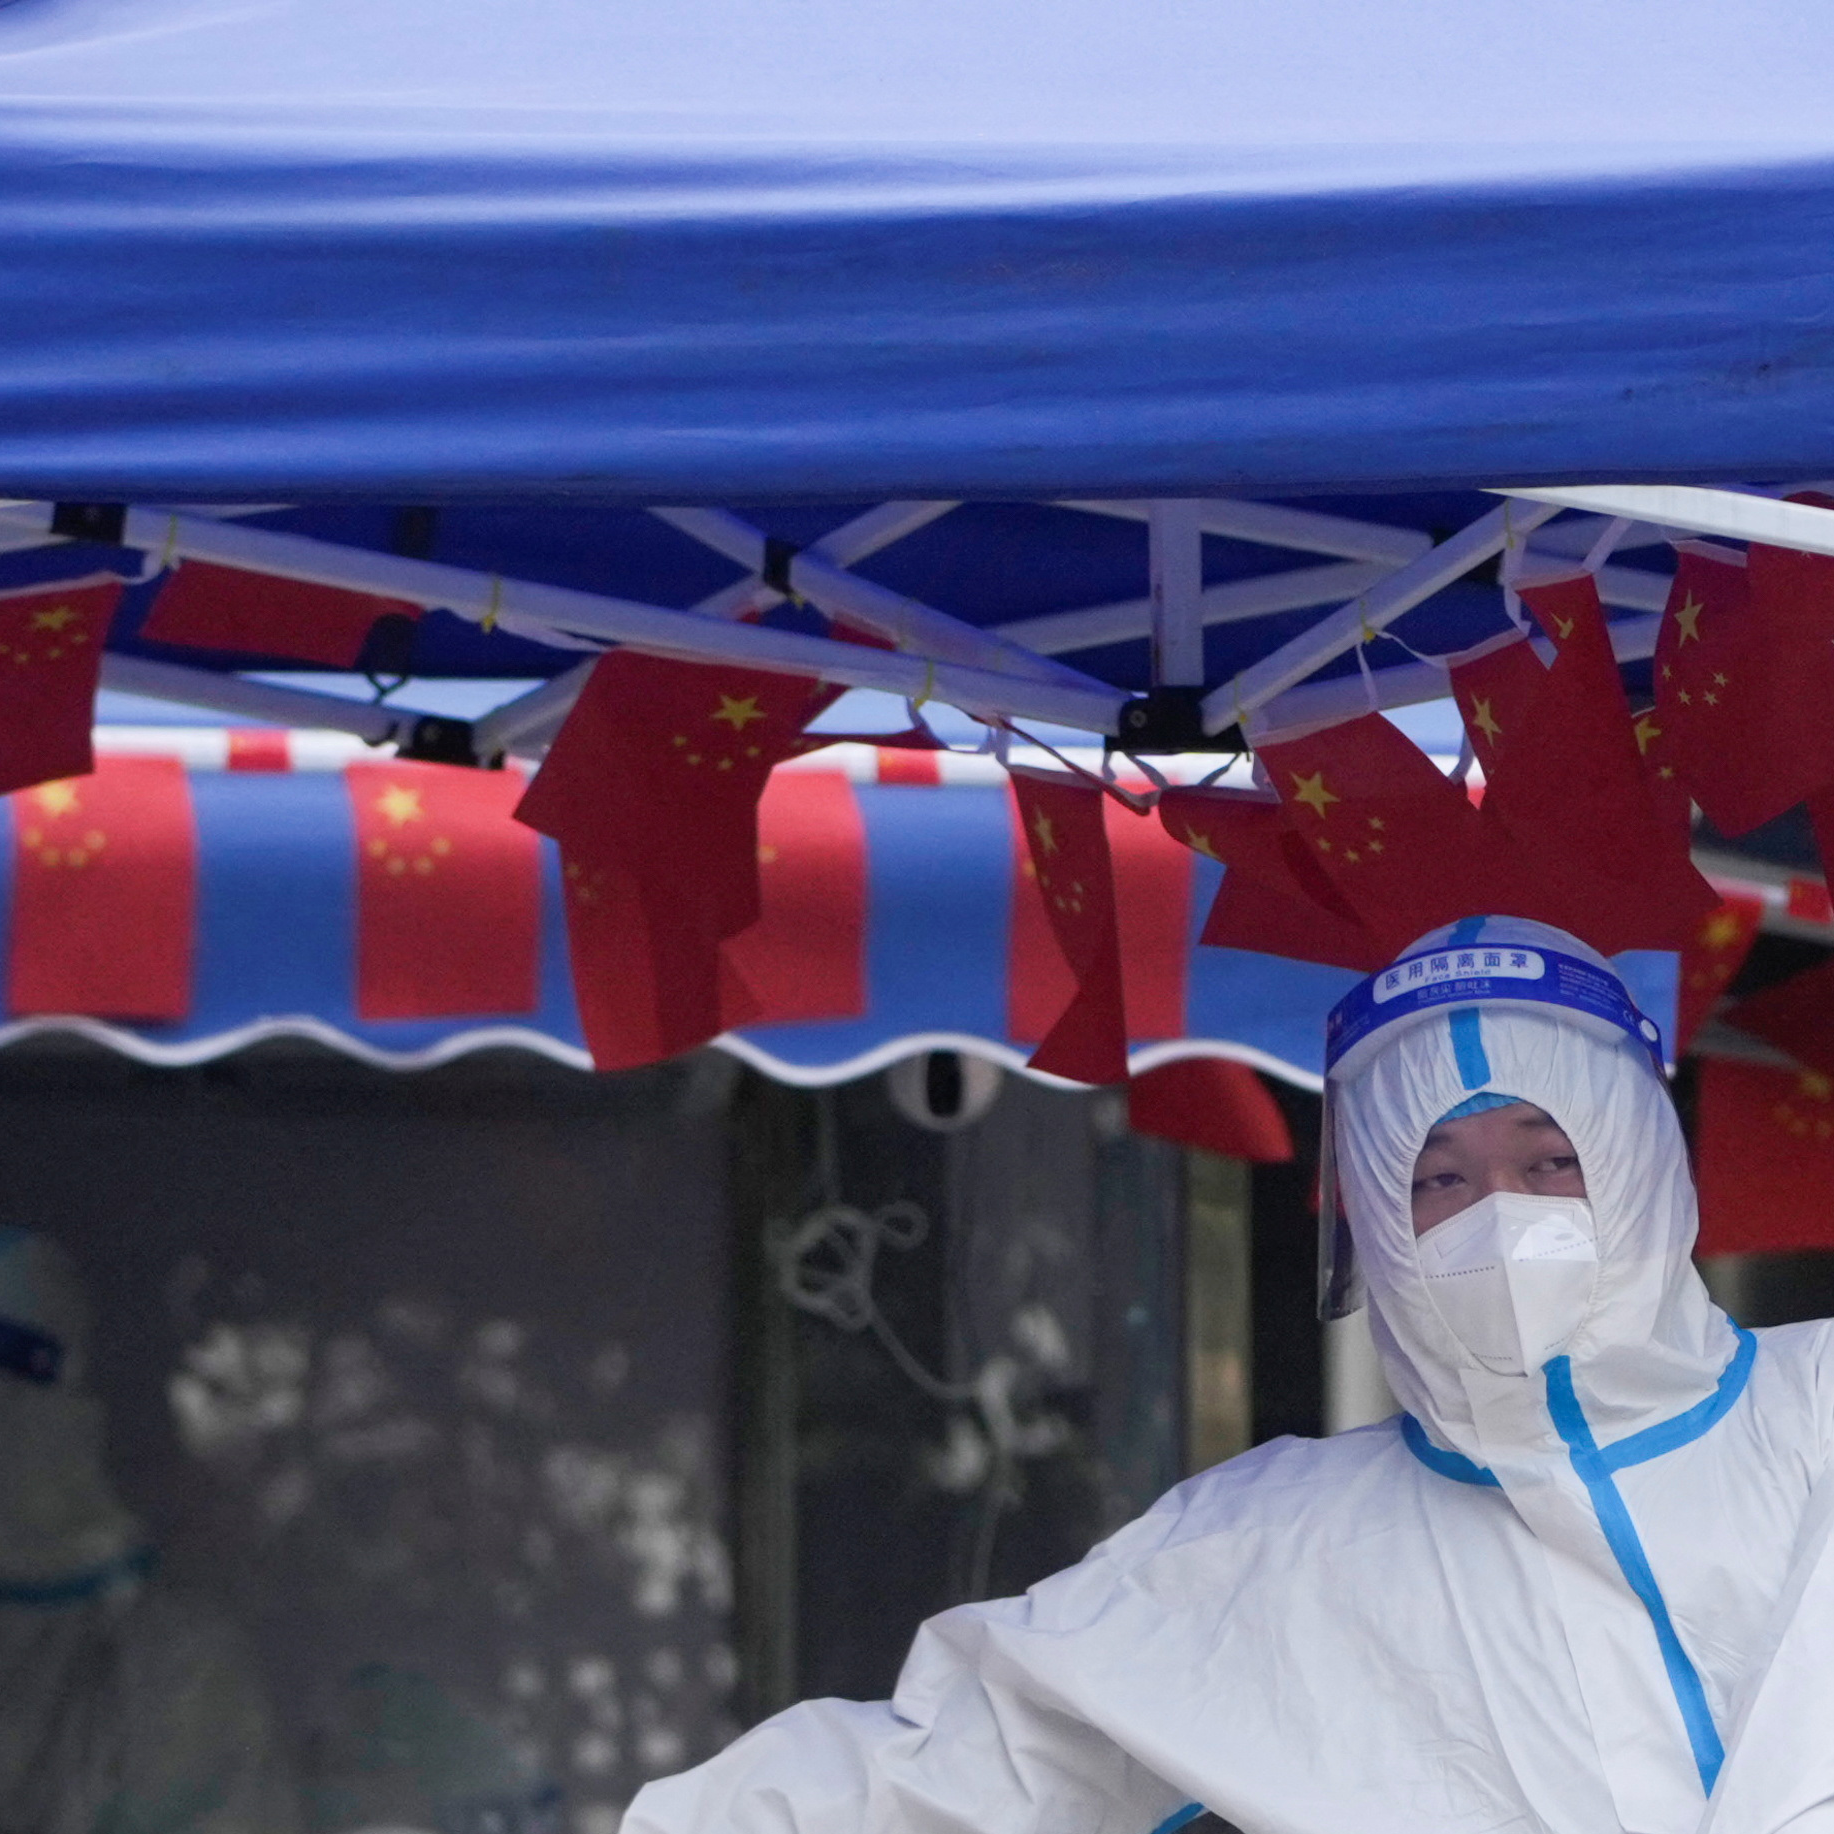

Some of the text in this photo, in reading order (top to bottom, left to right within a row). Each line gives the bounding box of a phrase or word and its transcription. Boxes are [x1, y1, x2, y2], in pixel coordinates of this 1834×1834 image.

[1385, 952, 1529, 991] 医用隔离面罩
